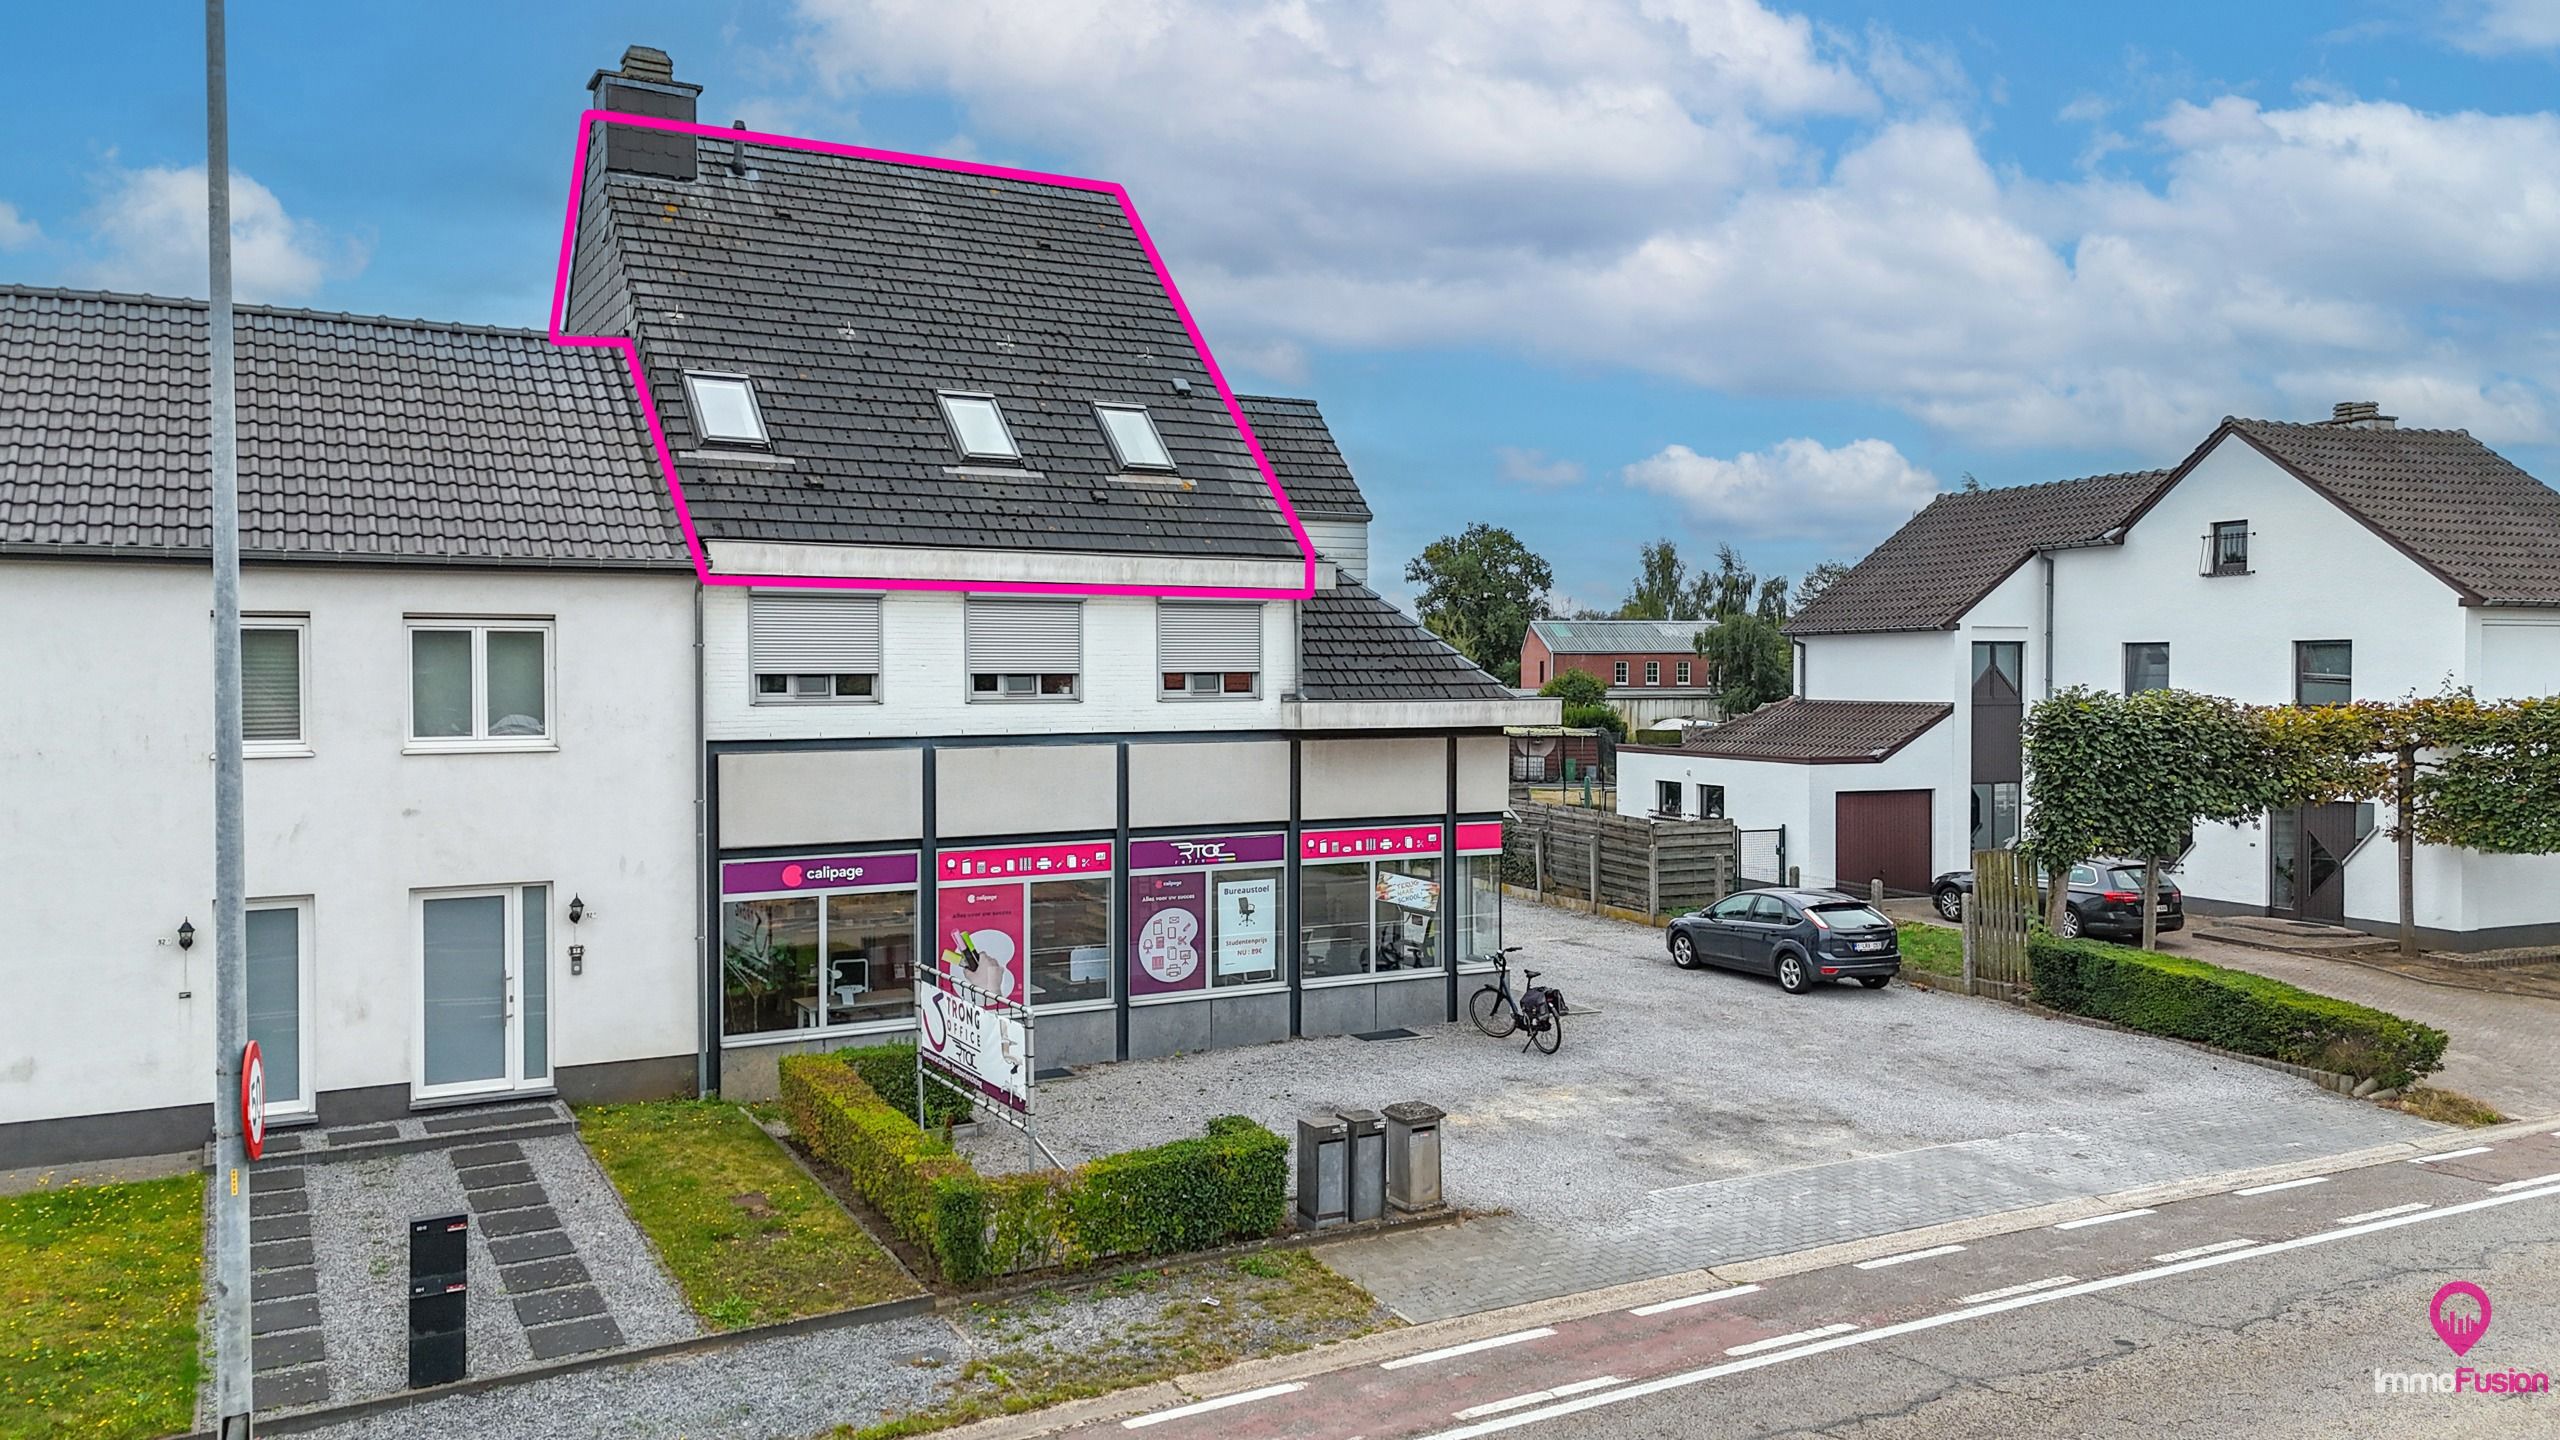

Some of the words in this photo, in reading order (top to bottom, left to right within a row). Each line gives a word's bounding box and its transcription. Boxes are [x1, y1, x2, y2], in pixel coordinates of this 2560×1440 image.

[806, 865, 864, 882] calipage
[1223, 885, 1270, 895] Bureaustoel
[1397, 880, 1419, 889] TERUG
[1225, 937, 1268, 947] Studentenprijs
[947, 1019, 981, 1047] OFFICE
[251, 1075, 261, 1127] 50
